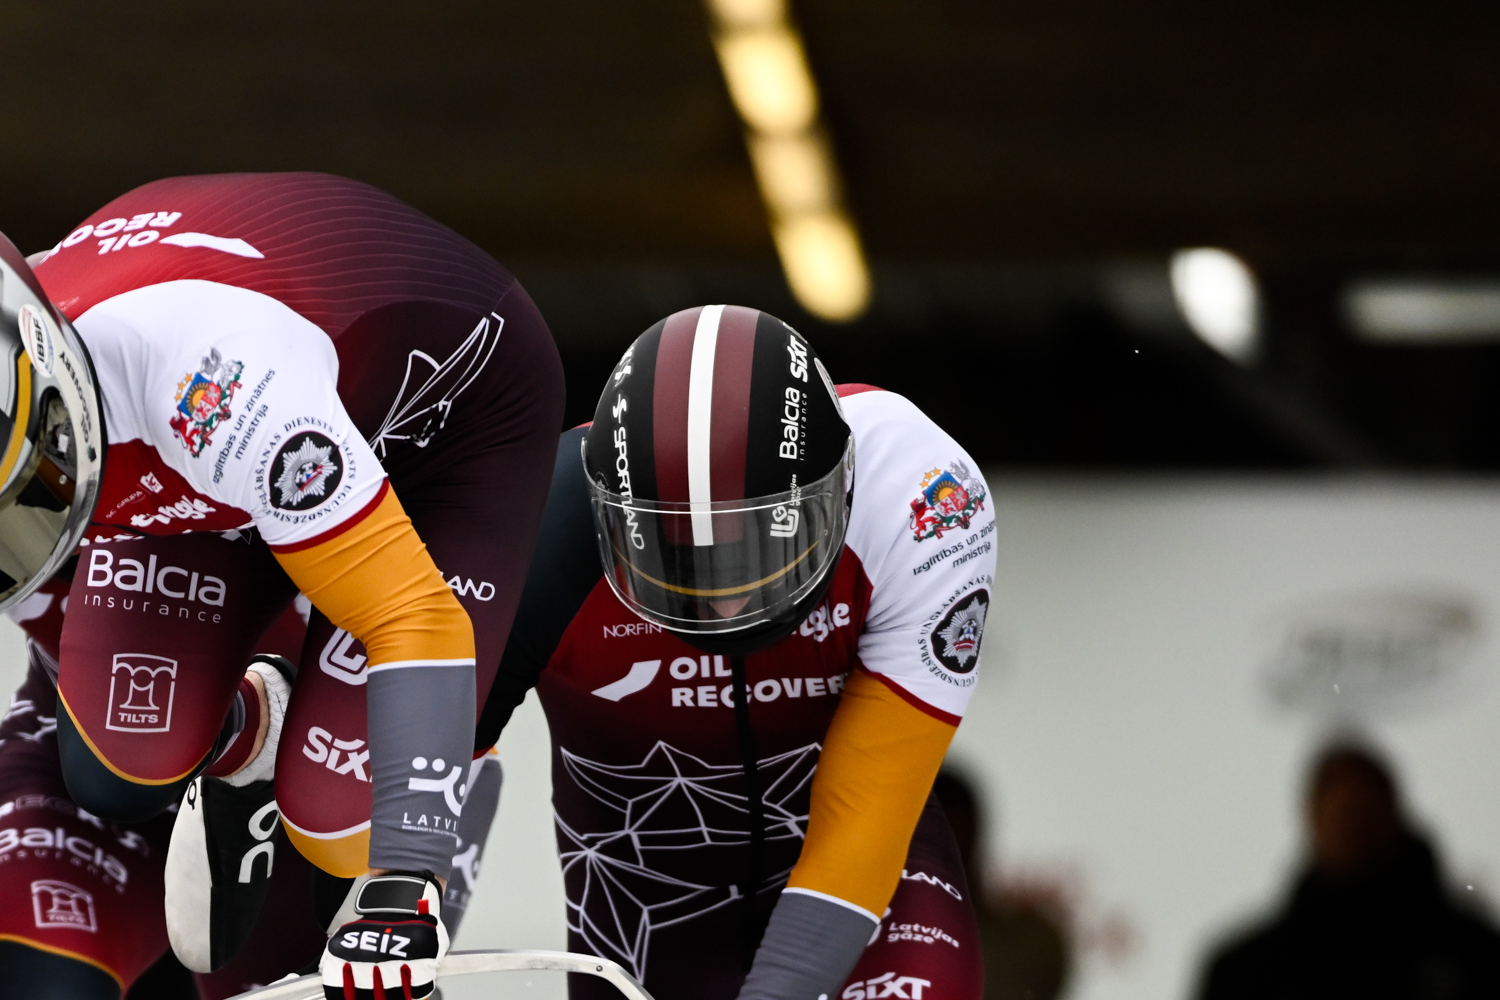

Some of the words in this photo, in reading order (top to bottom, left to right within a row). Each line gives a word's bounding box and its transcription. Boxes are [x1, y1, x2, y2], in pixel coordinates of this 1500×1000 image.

[98, 230, 160, 255] OIL
[234, 413, 247, 431] un
[244, 368, 276, 413] zinātnes
[235, 403, 269, 460] ministrija
[283, 416, 334, 433] DIENESTS
[779, 387, 800, 460] Balcia
[799, 393, 808, 461] insurance
[613, 426, 645, 550] SPORTLAND
[966, 533, 979, 545] un
[952, 541, 992, 568] ministrija
[87, 549, 227, 607] Balcia
[84, 594, 222, 623] insurance
[669, 655, 733, 680] OIL
[118, 712, 159, 724] TILTS
[340, 928, 411, 958] SEIZ
[889, 922, 960, 948] Latvijas
